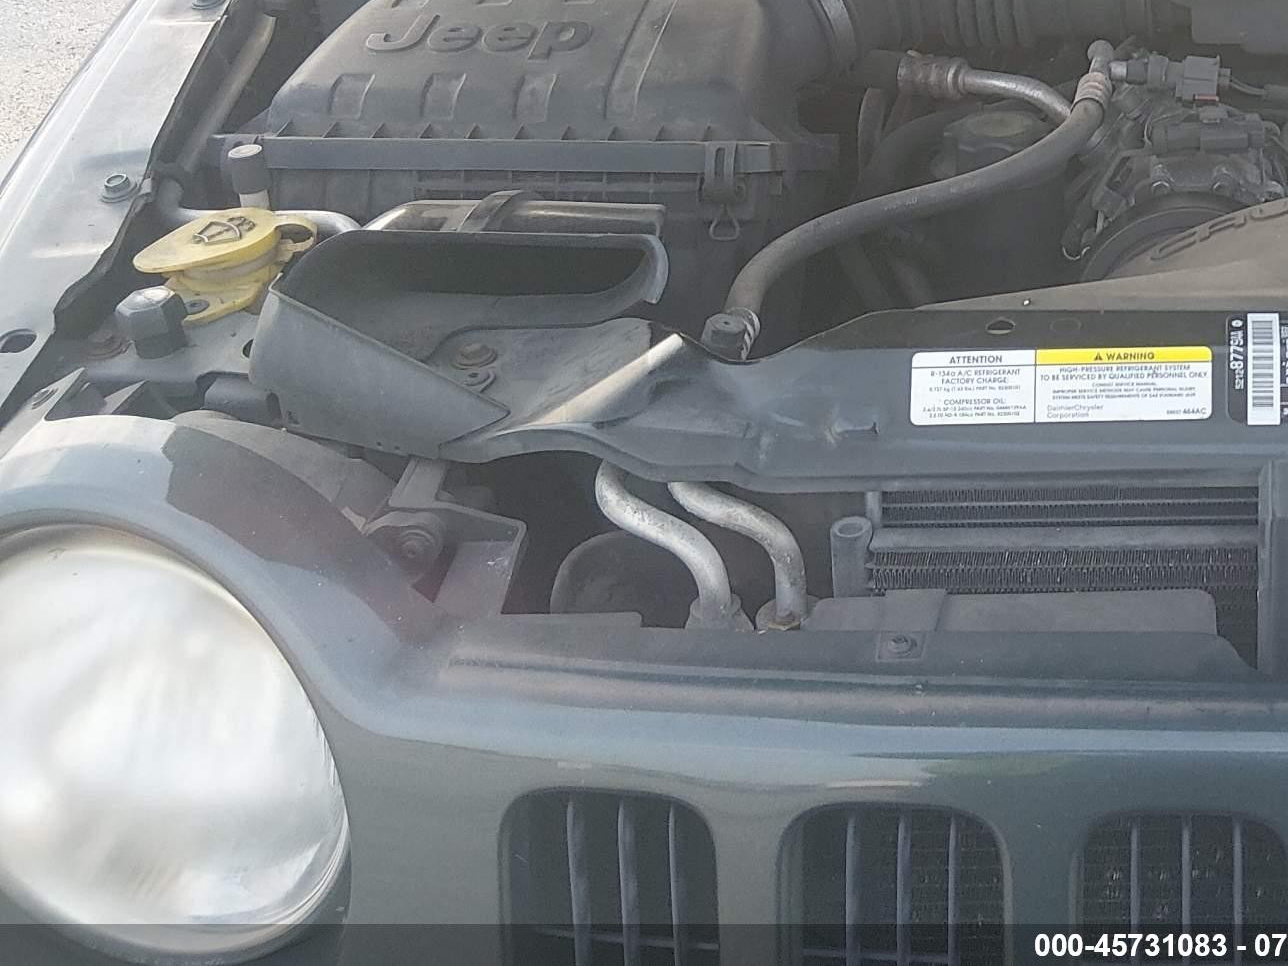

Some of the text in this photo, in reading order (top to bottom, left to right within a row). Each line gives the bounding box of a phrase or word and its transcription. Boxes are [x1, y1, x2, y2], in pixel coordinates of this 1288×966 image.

[366, 14, 593, 61] Jeep
[949, 355, 1002, 364] ATTENTION
[1106, 352, 1155, 361] WARNING
